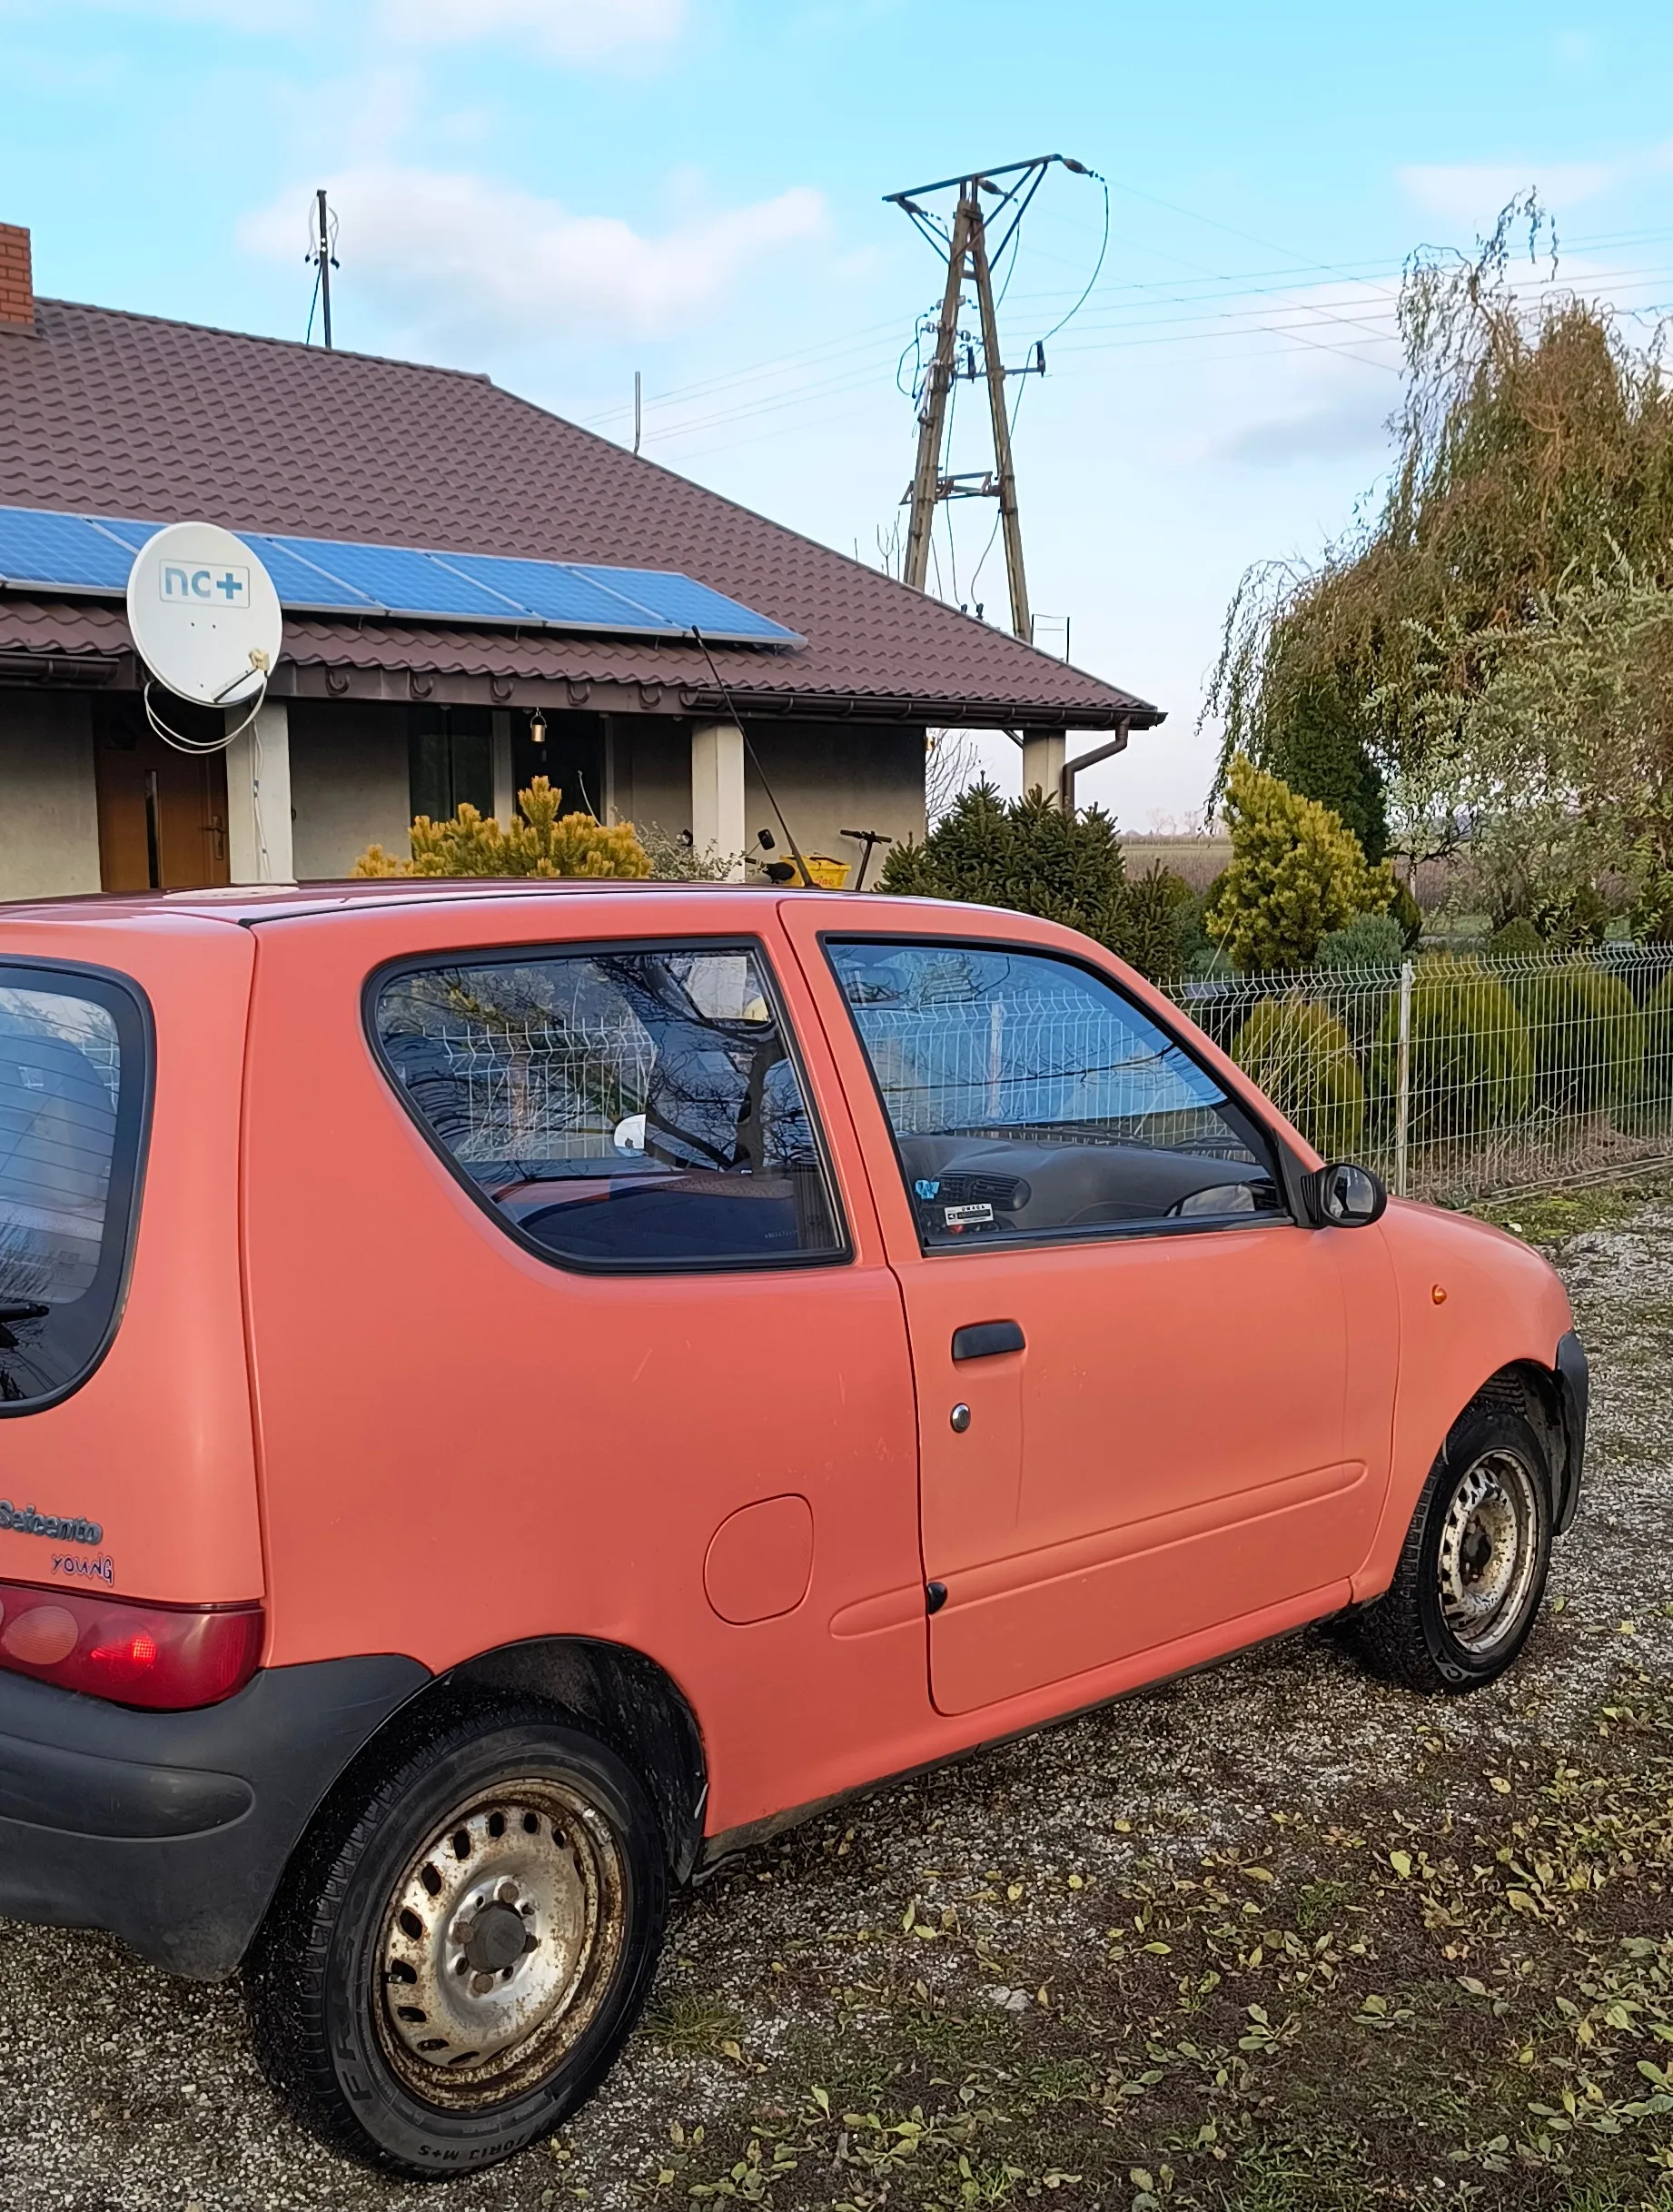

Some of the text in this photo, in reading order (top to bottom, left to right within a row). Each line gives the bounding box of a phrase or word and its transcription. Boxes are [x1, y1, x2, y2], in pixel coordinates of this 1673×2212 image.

[165, 567, 243, 600] nc+
[0, 1499, 103, 1545] Seicento
[52, 1552, 114, 1587] YOUNG
